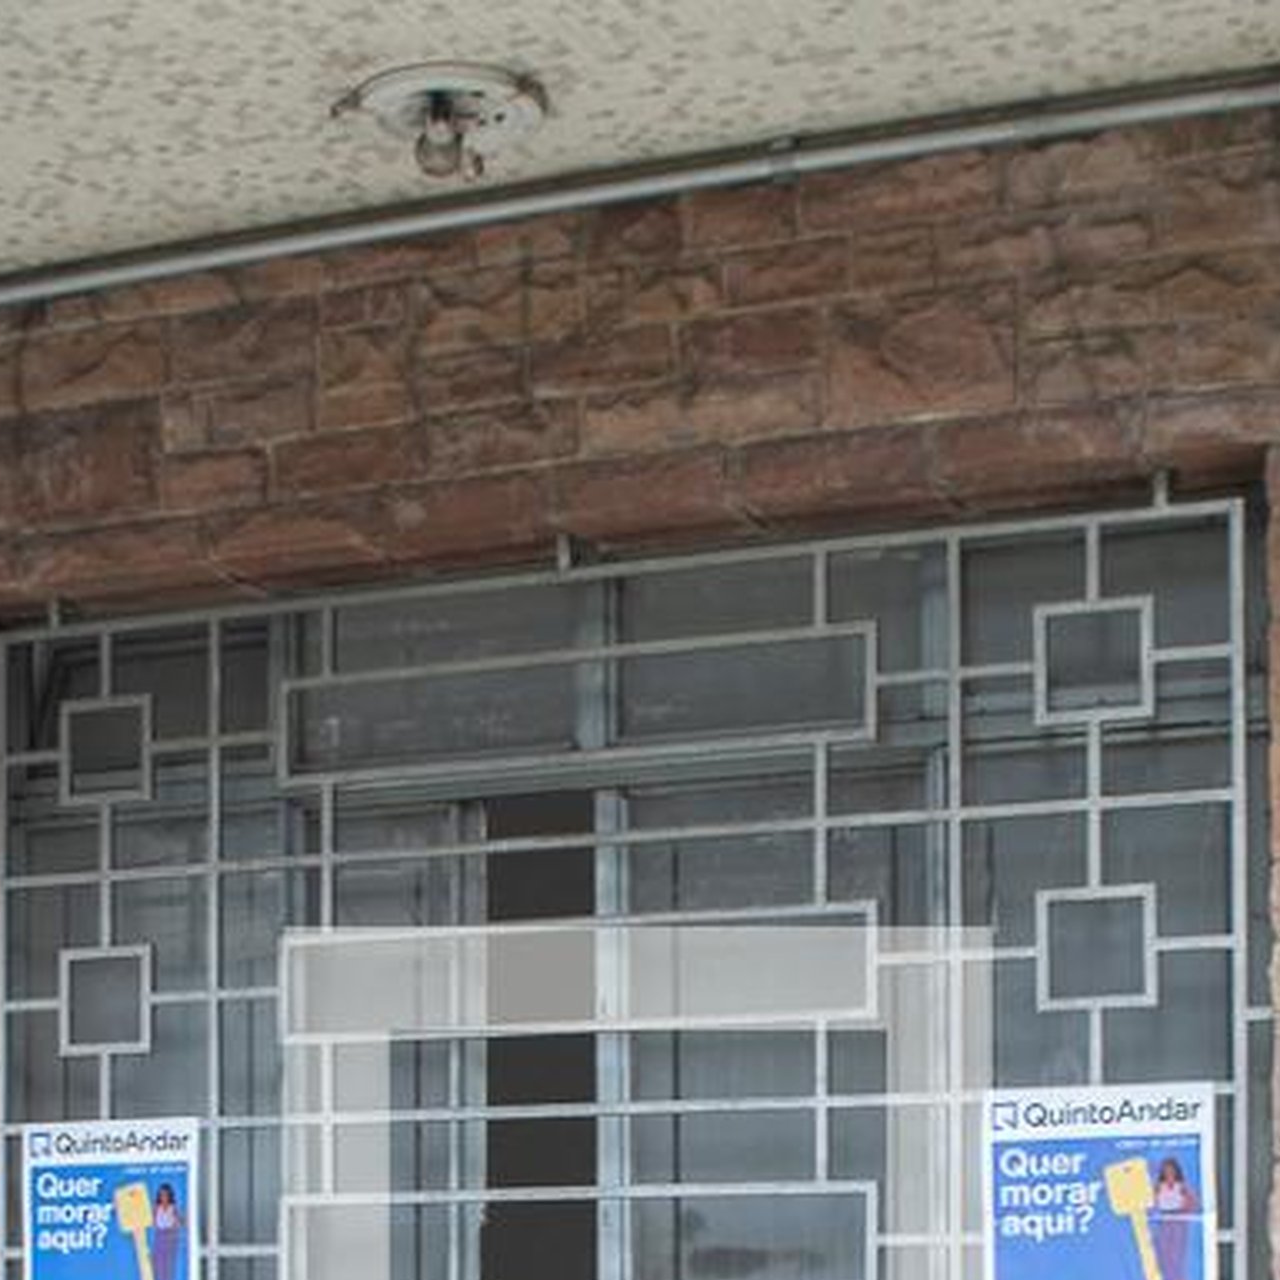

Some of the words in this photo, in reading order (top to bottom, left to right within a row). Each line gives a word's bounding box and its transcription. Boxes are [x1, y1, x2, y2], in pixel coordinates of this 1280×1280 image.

[1023, 1098, 1201, 1129] QuintoAndar
[55, 1130, 189, 1154] QuintoAndar
[999, 1149, 1086, 1179] Quer
[36, 1172, 102, 1199] Quer
[1000, 1180, 1101, 1207] morar
[36, 1202, 113, 1225] morar
[1000, 1208, 1095, 1242] aqui?
[36, 1222, 108, 1254] aqui?
